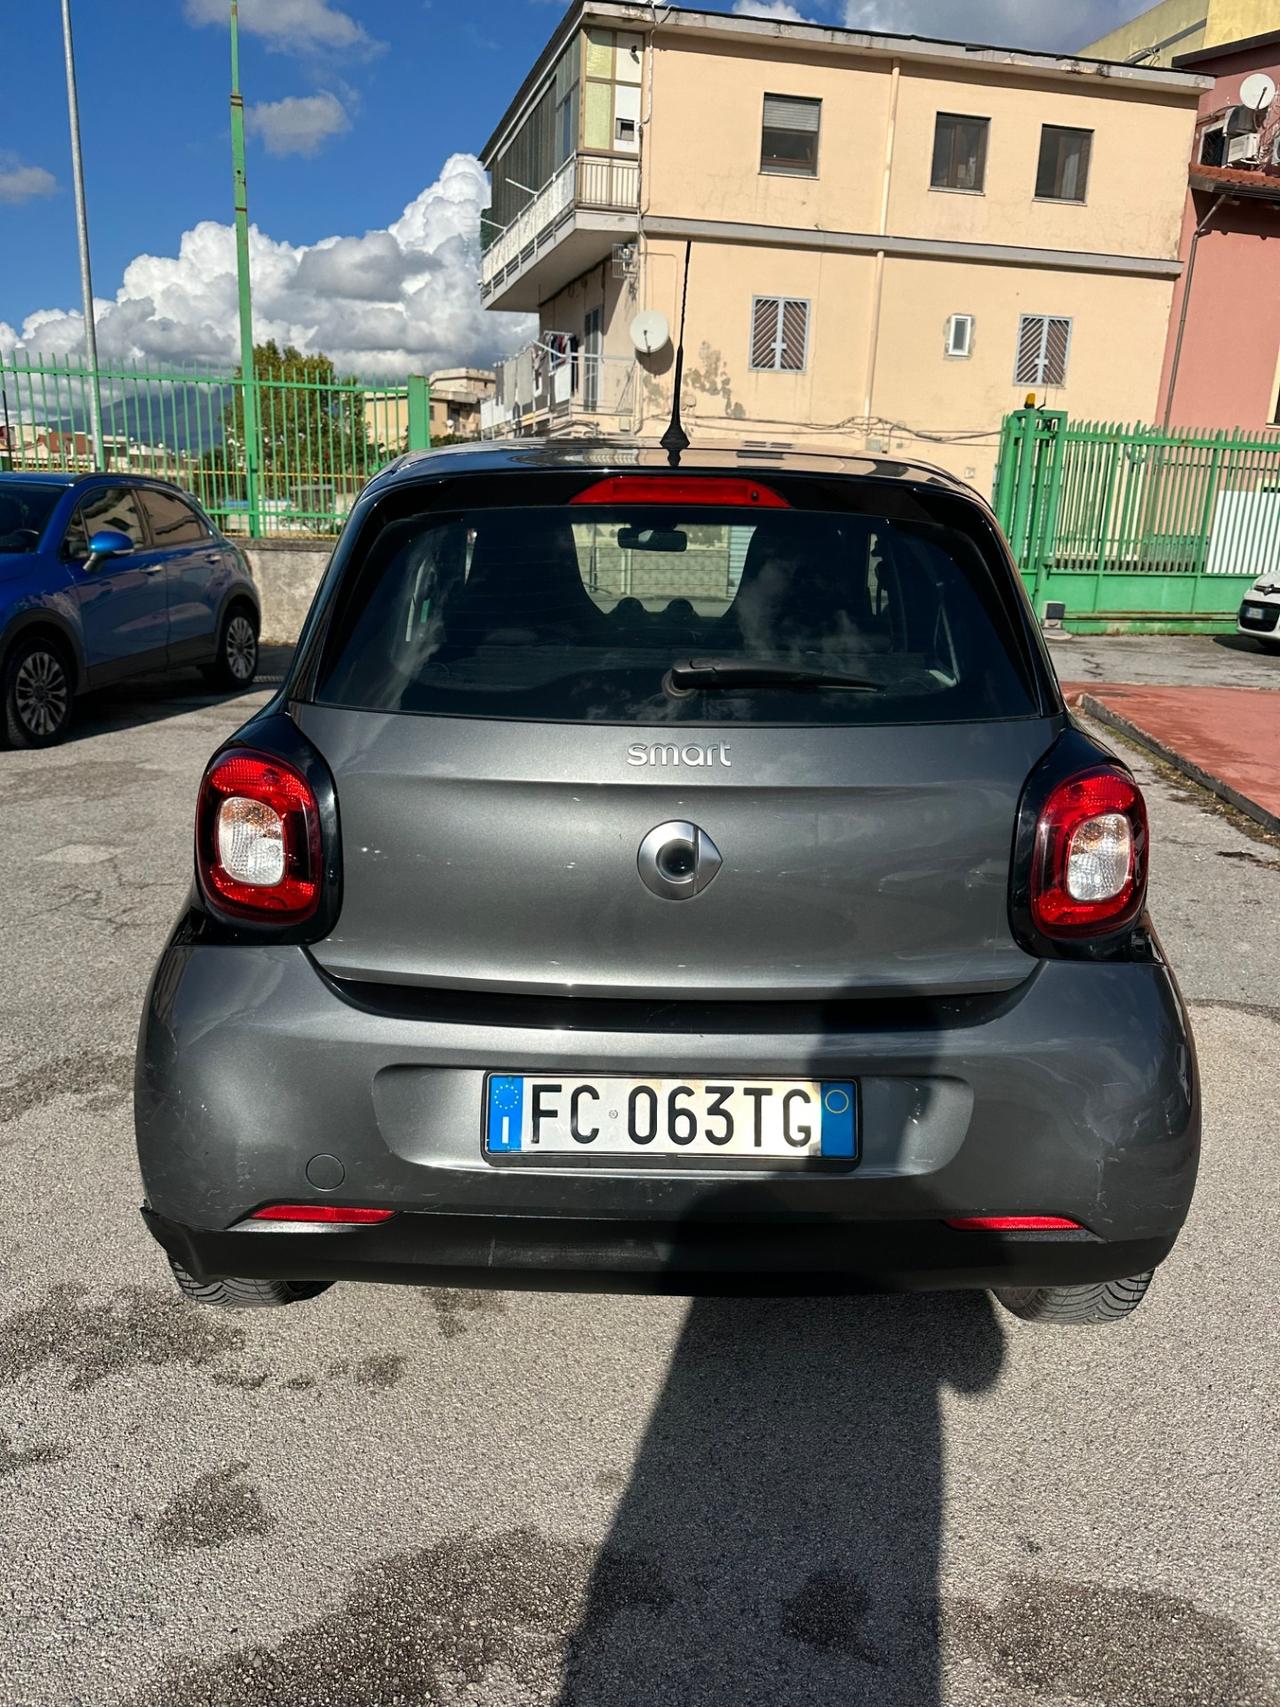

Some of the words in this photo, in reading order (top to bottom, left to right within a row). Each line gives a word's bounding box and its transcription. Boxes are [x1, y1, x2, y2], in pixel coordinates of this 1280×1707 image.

[626, 741, 732, 767] smart
[531, 1084, 600, 1145] FC
[501, 1116, 510, 1144] I
